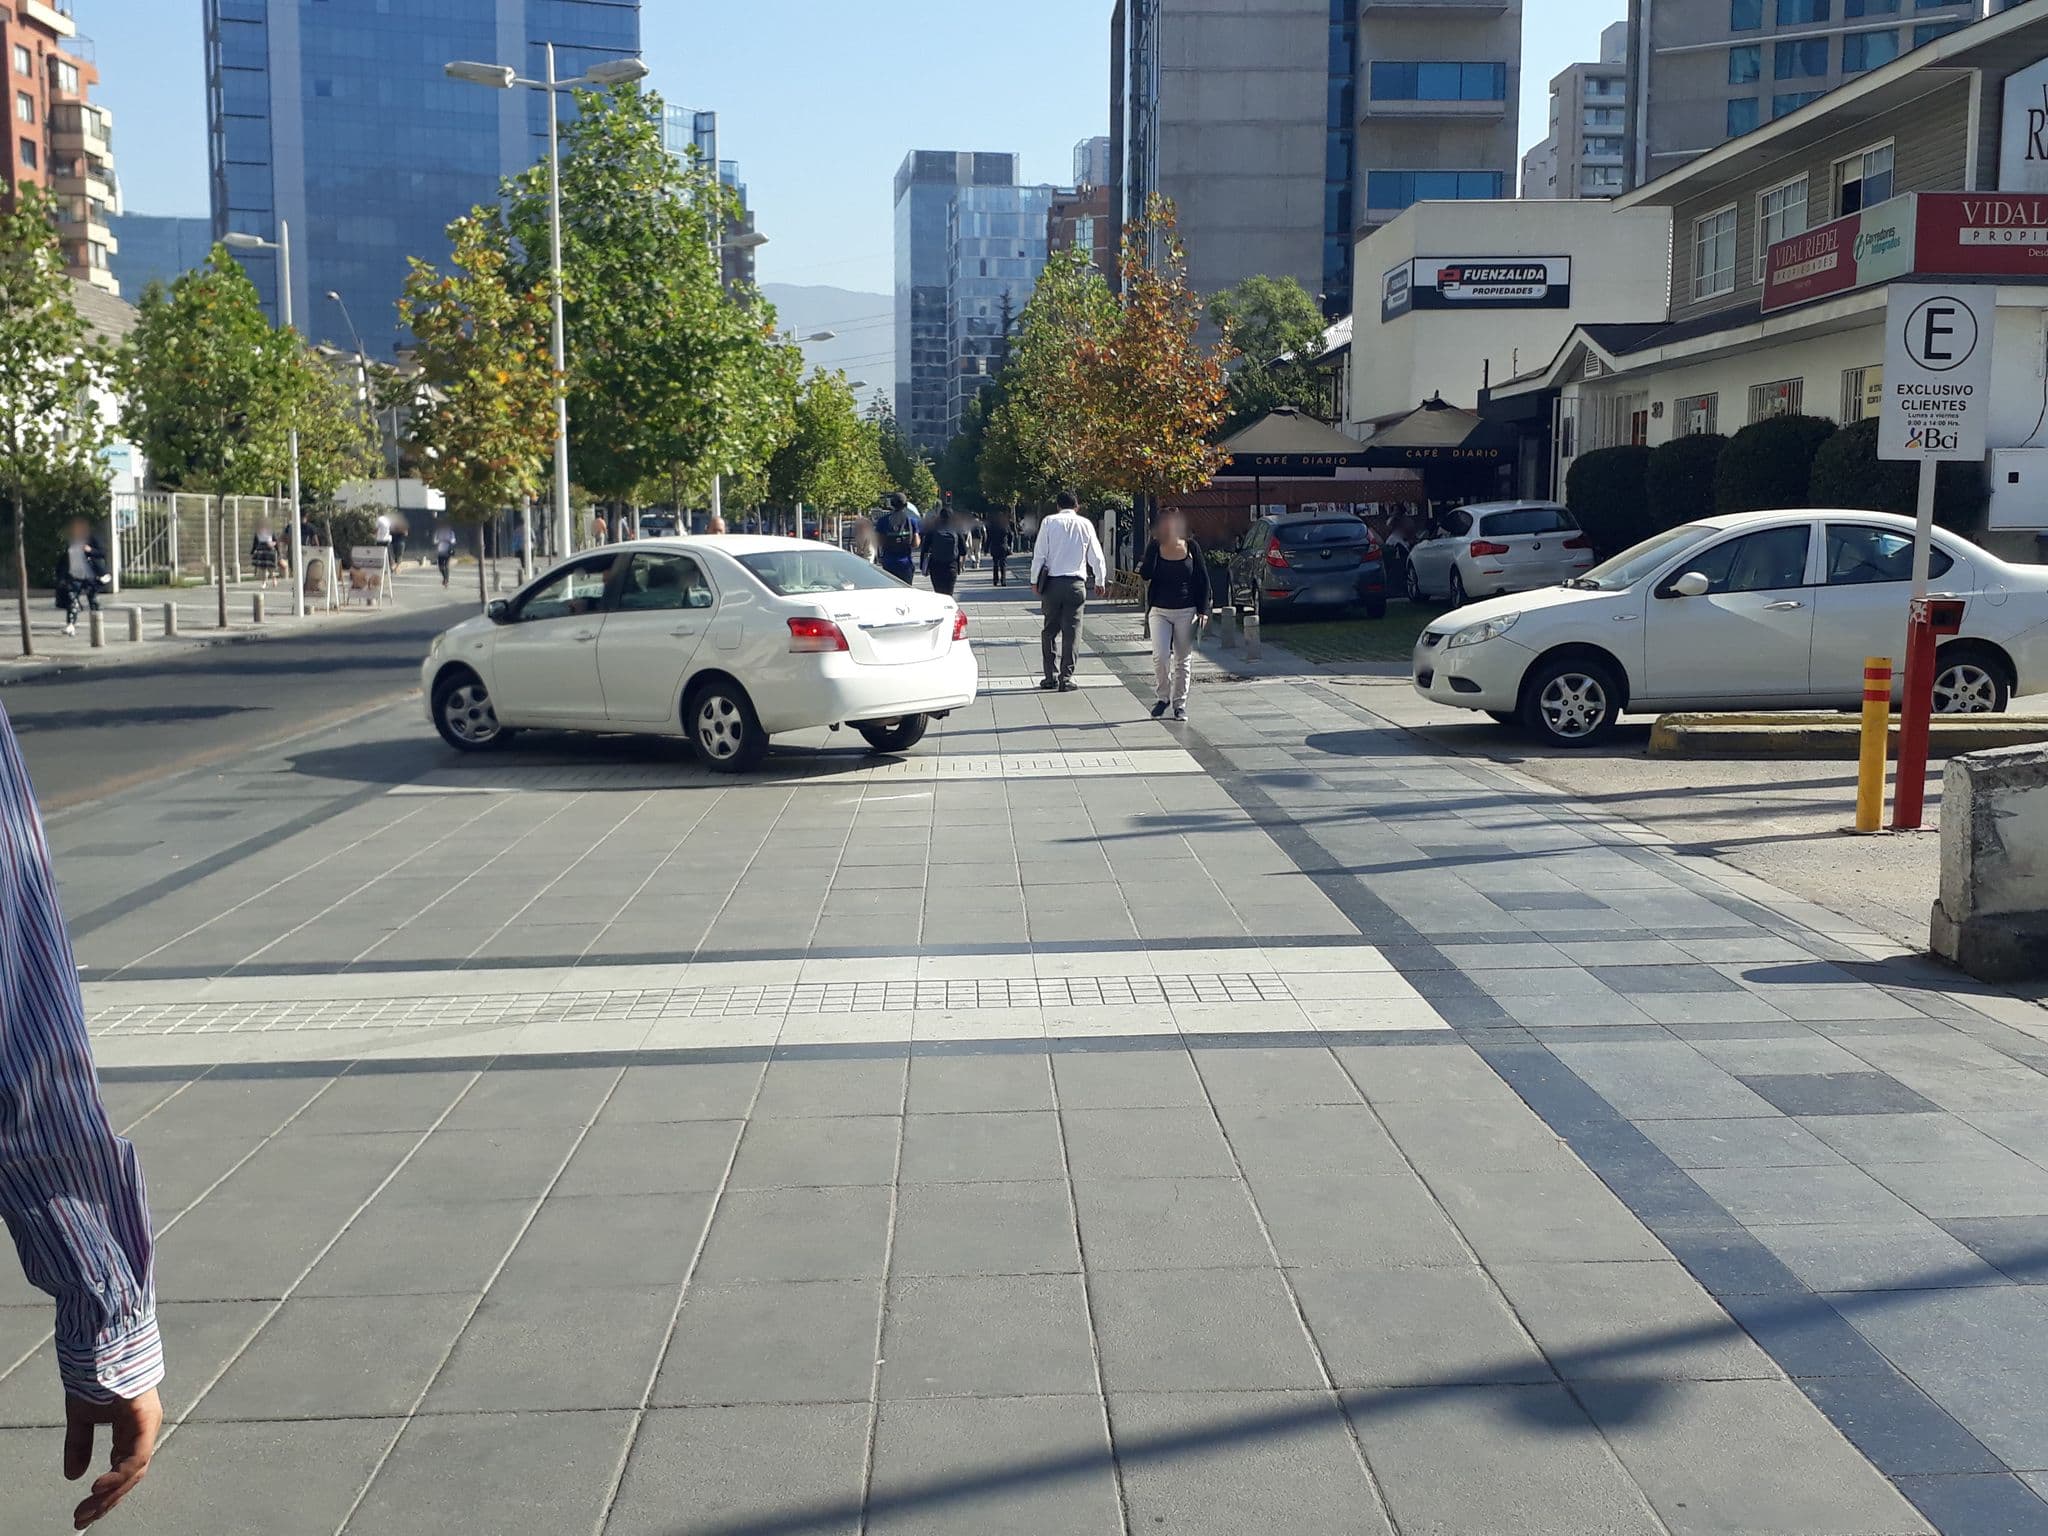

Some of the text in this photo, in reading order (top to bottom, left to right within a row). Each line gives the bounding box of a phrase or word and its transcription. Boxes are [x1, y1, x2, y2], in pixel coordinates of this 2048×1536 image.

[1962, 202, 2048, 225] VIDAL
[1973, 231, 2048, 241] PROPI
[1775, 229, 1840, 268] VIDAL RIEDEL
[1463, 269, 1545, 281] FUENZALIDA
[1472, 287, 1533, 295] PROPIEDADES
[1924, 308, 1955, 359] E
[1897, 384, 1974, 396] EXCLUSIVO
[1901, 400, 1967, 411] CLIENTES
[1925, 428, 1958, 449] Bci
[1406, 448, 1499, 458] CAFÉ DIARIO
[1255, 455, 1348, 465] CAFÉ DIARIO
